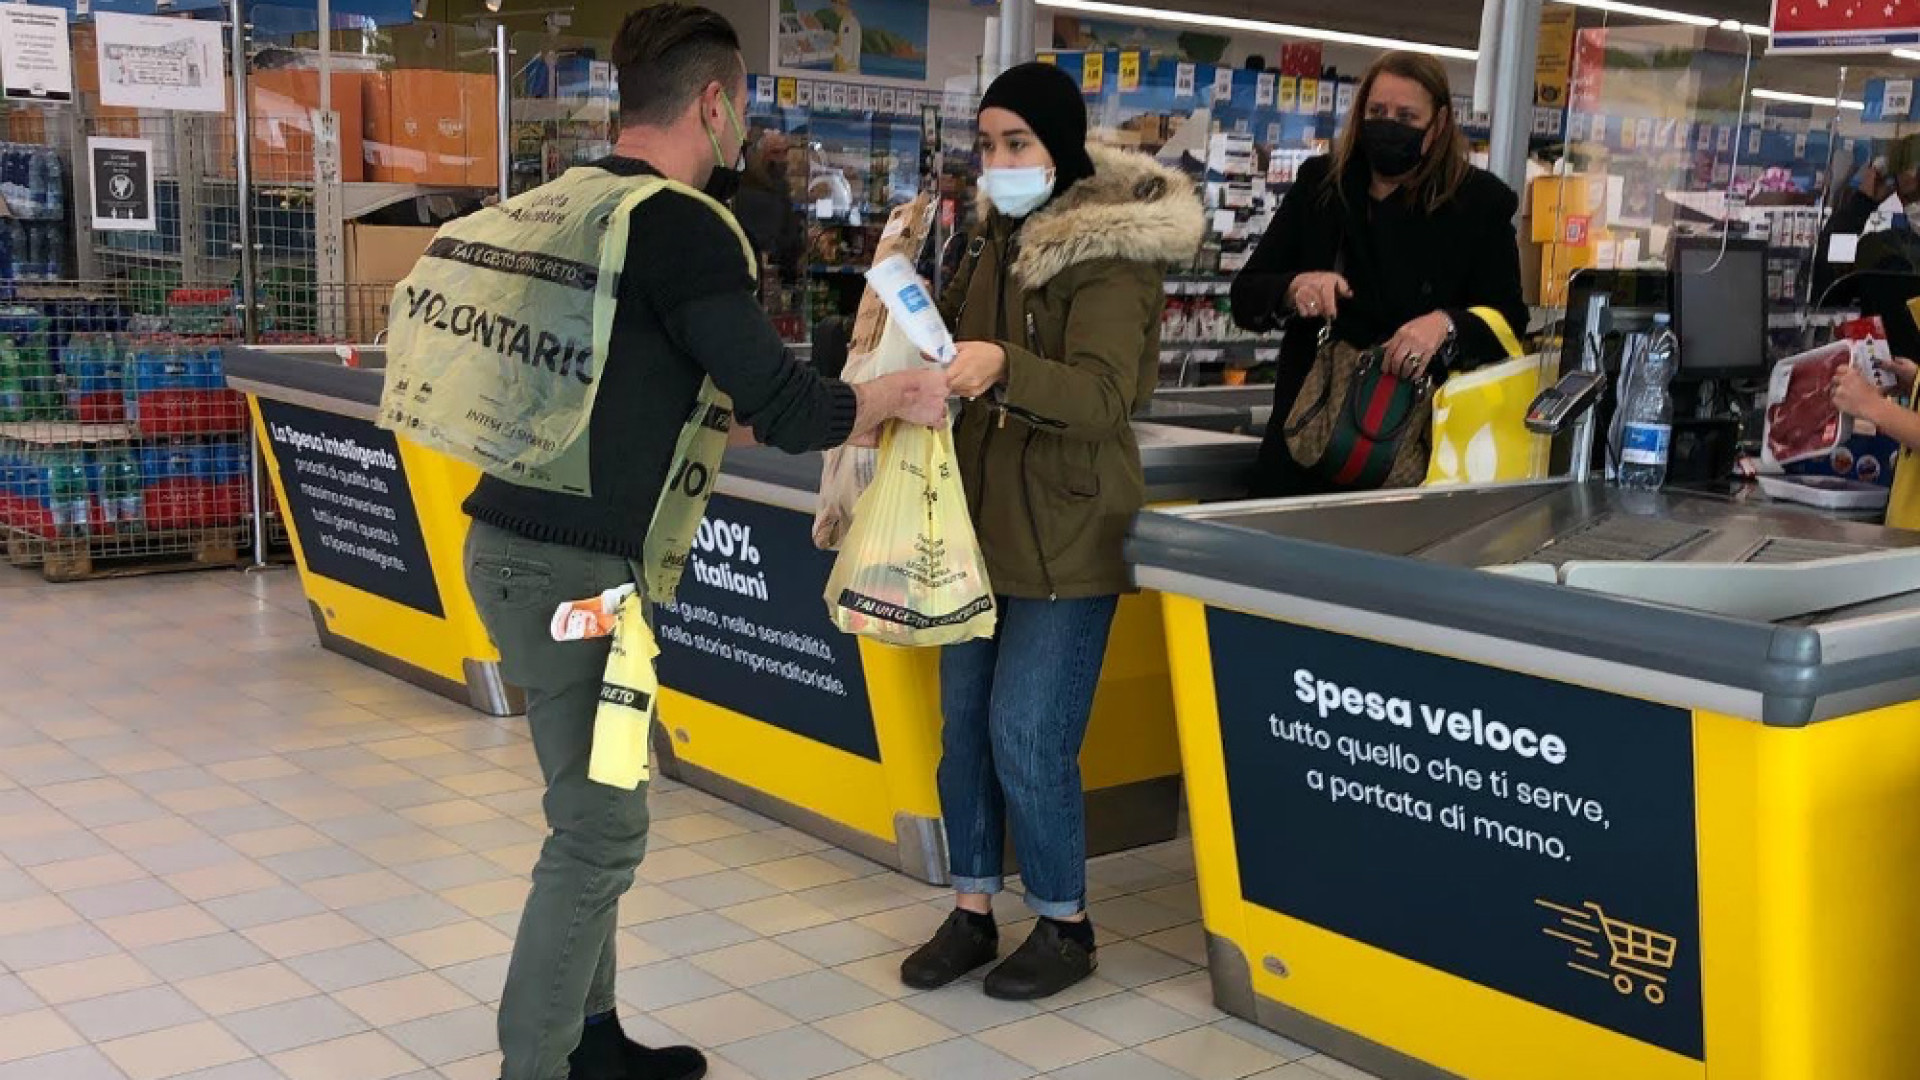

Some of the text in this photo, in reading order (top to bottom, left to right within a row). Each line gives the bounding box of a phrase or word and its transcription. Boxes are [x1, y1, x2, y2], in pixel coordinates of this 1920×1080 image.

[691, 515, 761, 566] 00%
[691, 553, 769, 602] italiani
[660, 624, 694, 648] nella
[693, 633, 733, 660] storia
[680, 602, 722, 625] gusto,
[722, 614, 758, 639] nella
[1294, 668, 1568, 765] Spesa veloce
[1268, 713, 1611, 830] tutto quello che ti serve,
[1306, 768, 1572, 862] a portata di mano.
